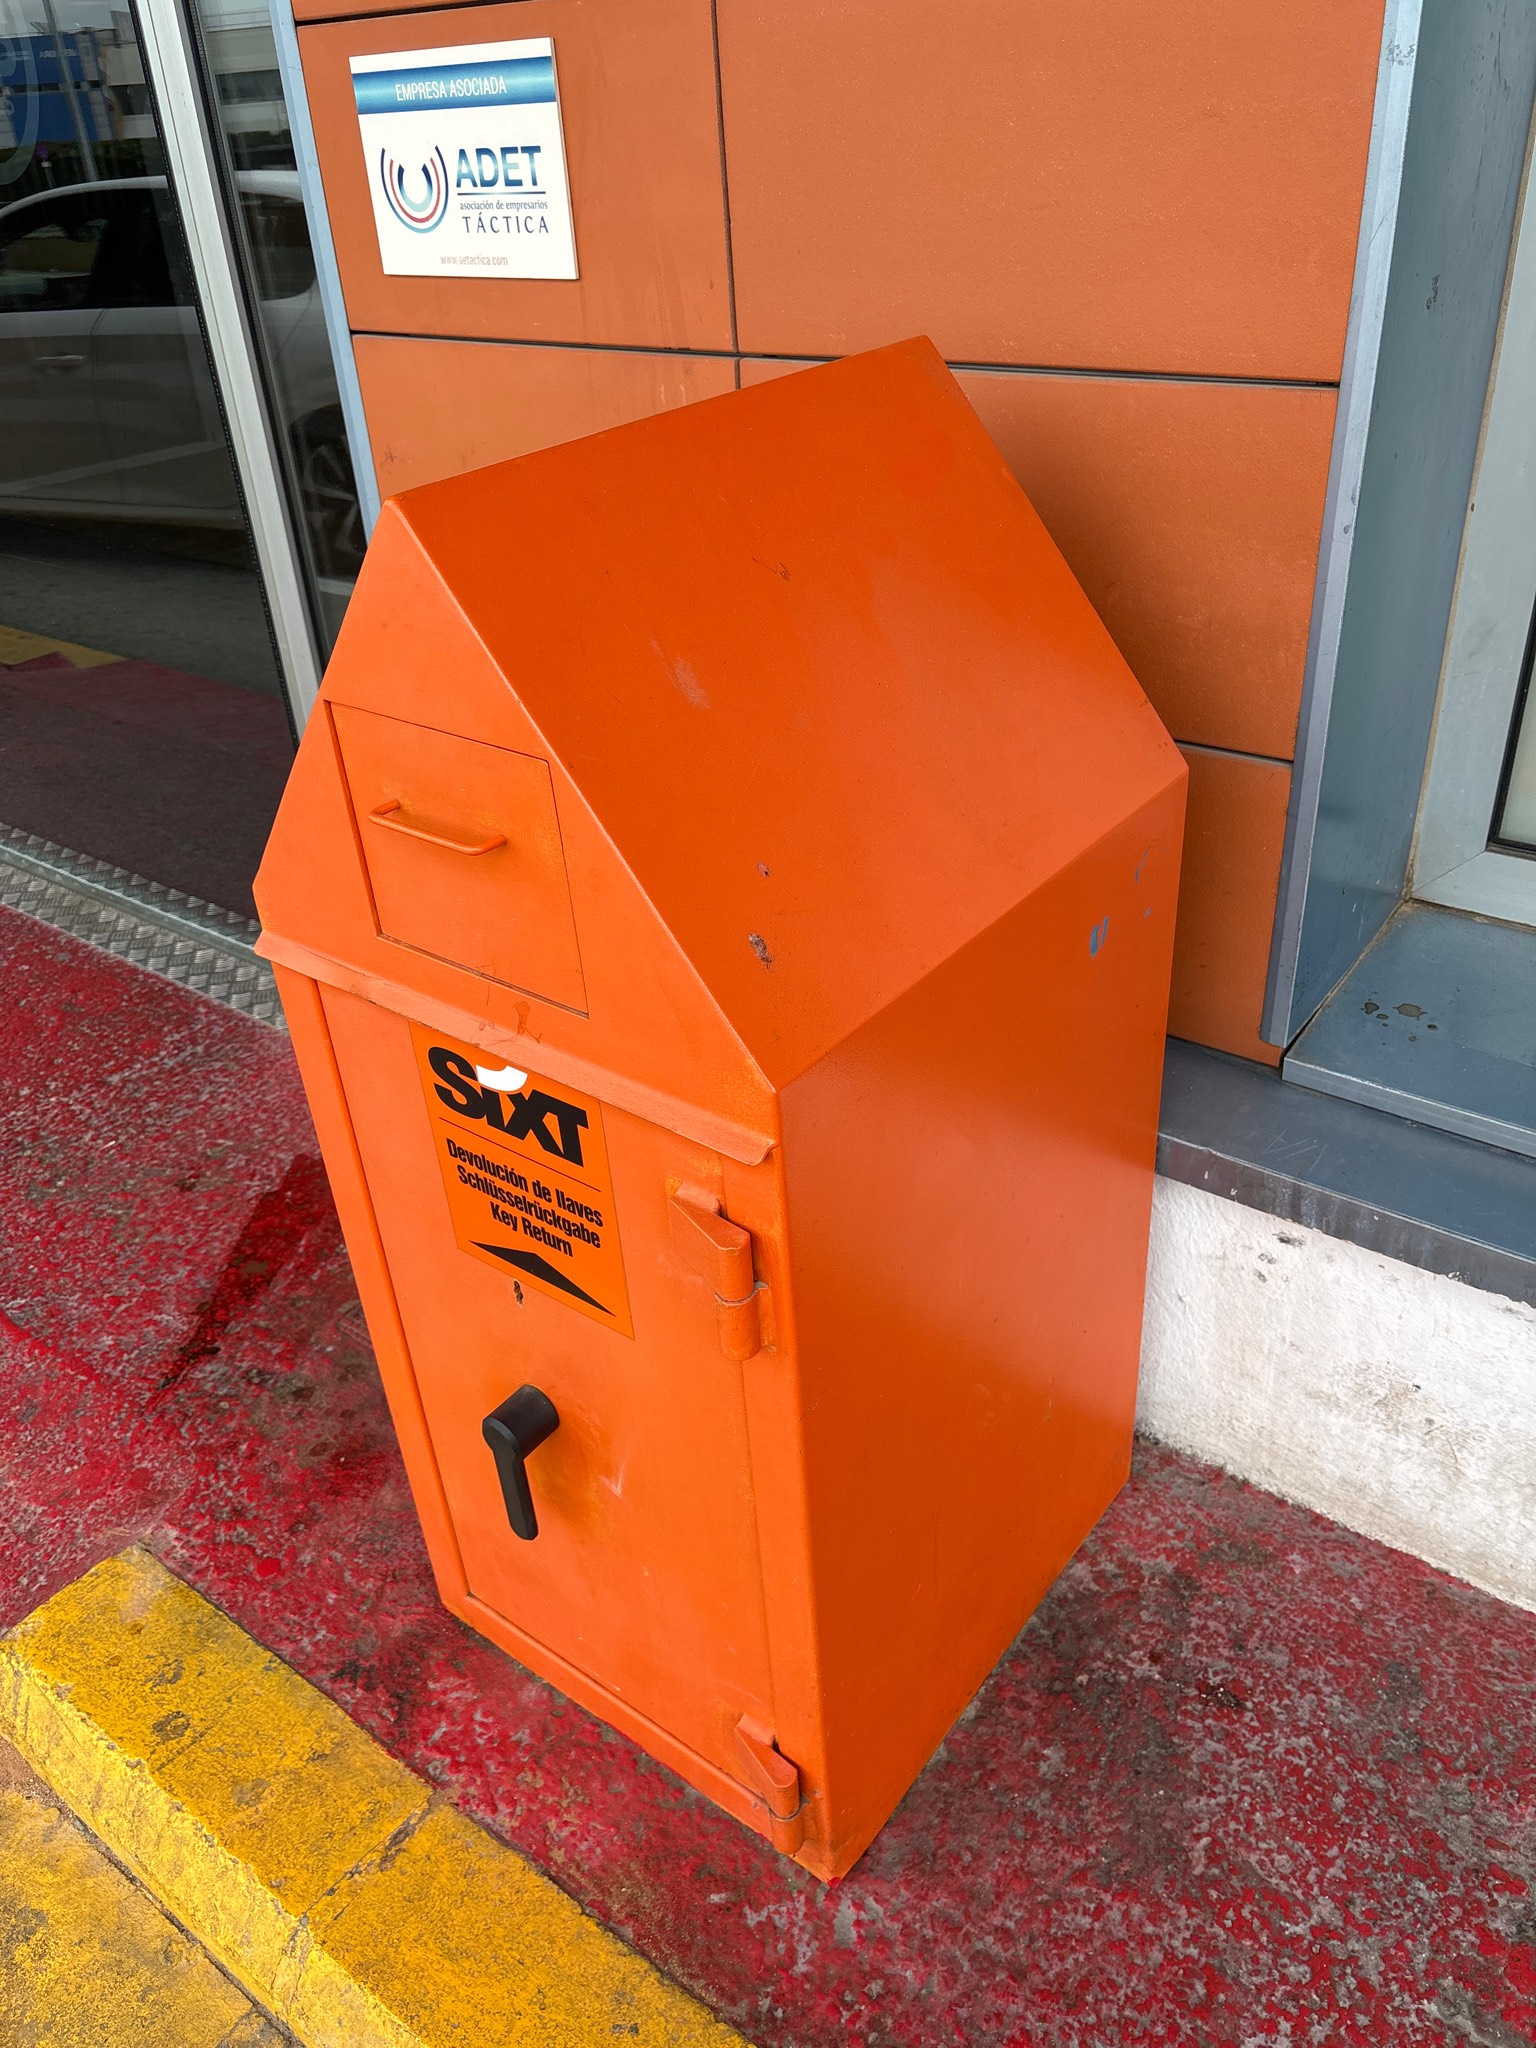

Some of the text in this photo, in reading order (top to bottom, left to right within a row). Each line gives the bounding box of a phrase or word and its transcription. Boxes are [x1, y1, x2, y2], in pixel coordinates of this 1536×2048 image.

[395, 75, 508, 101] EMPRESA ASOCIADA
[456, 145, 542, 188] ADET
[459, 199, 549, 212] asociación de empresarios
[461, 212, 549, 233] TÁCTICA
[446, 1137, 604, 1228] Devolución de llaves
[457, 1165, 602, 1249] Schlüsselrückgabe
[489, 1201, 574, 1258] Key Return
